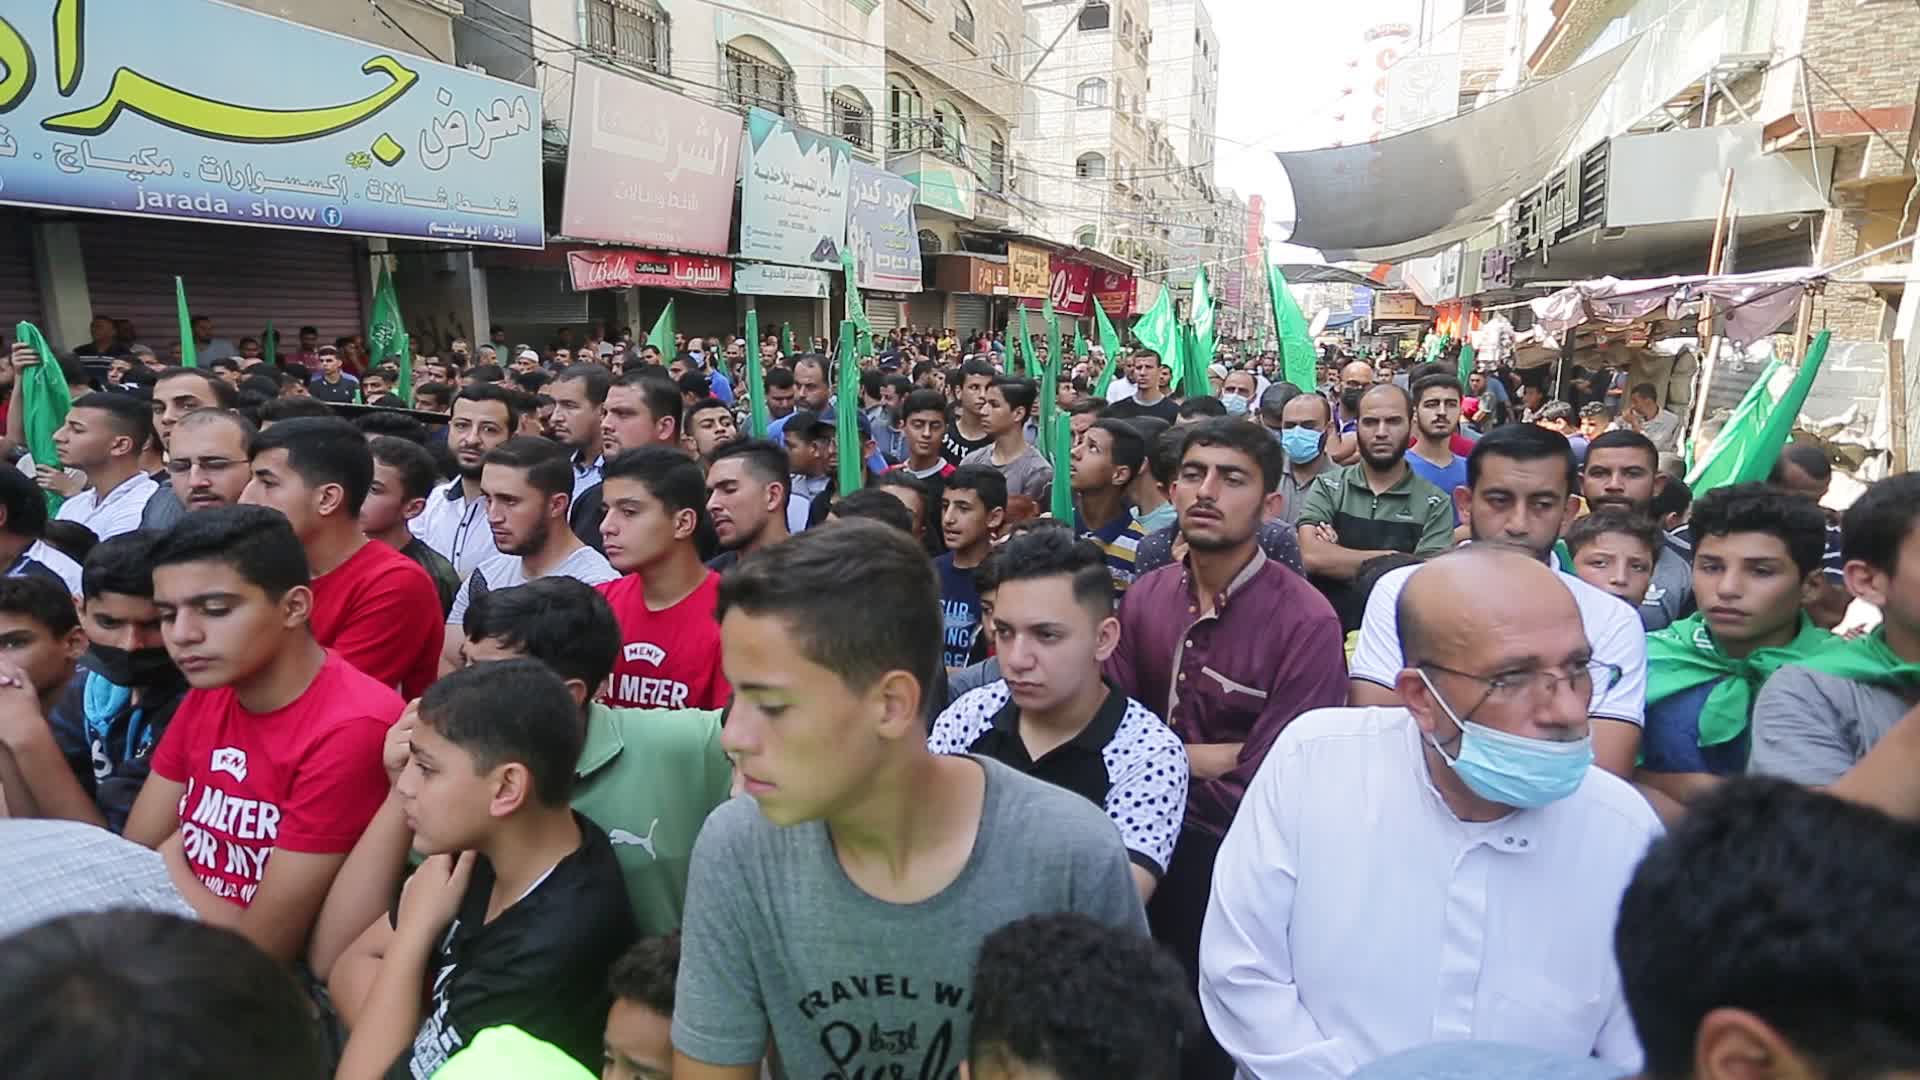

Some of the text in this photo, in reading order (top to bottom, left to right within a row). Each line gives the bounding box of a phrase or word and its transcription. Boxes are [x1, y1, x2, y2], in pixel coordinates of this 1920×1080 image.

[419, 87, 531, 170] معرض
[53, 138, 175, 181] مكياج
[200, 155, 349, 205] إكسسوارات
[366, 178, 449, 210] شالات
[135, 186, 317, 222] jarada show
[456, 193, 519, 217] شنط
[673, 258, 721, 284] الشرفا
[942, 433, 969, 458] STAY
[224, 840, 275, 881] MY
[934, 981, 974, 1013] W
